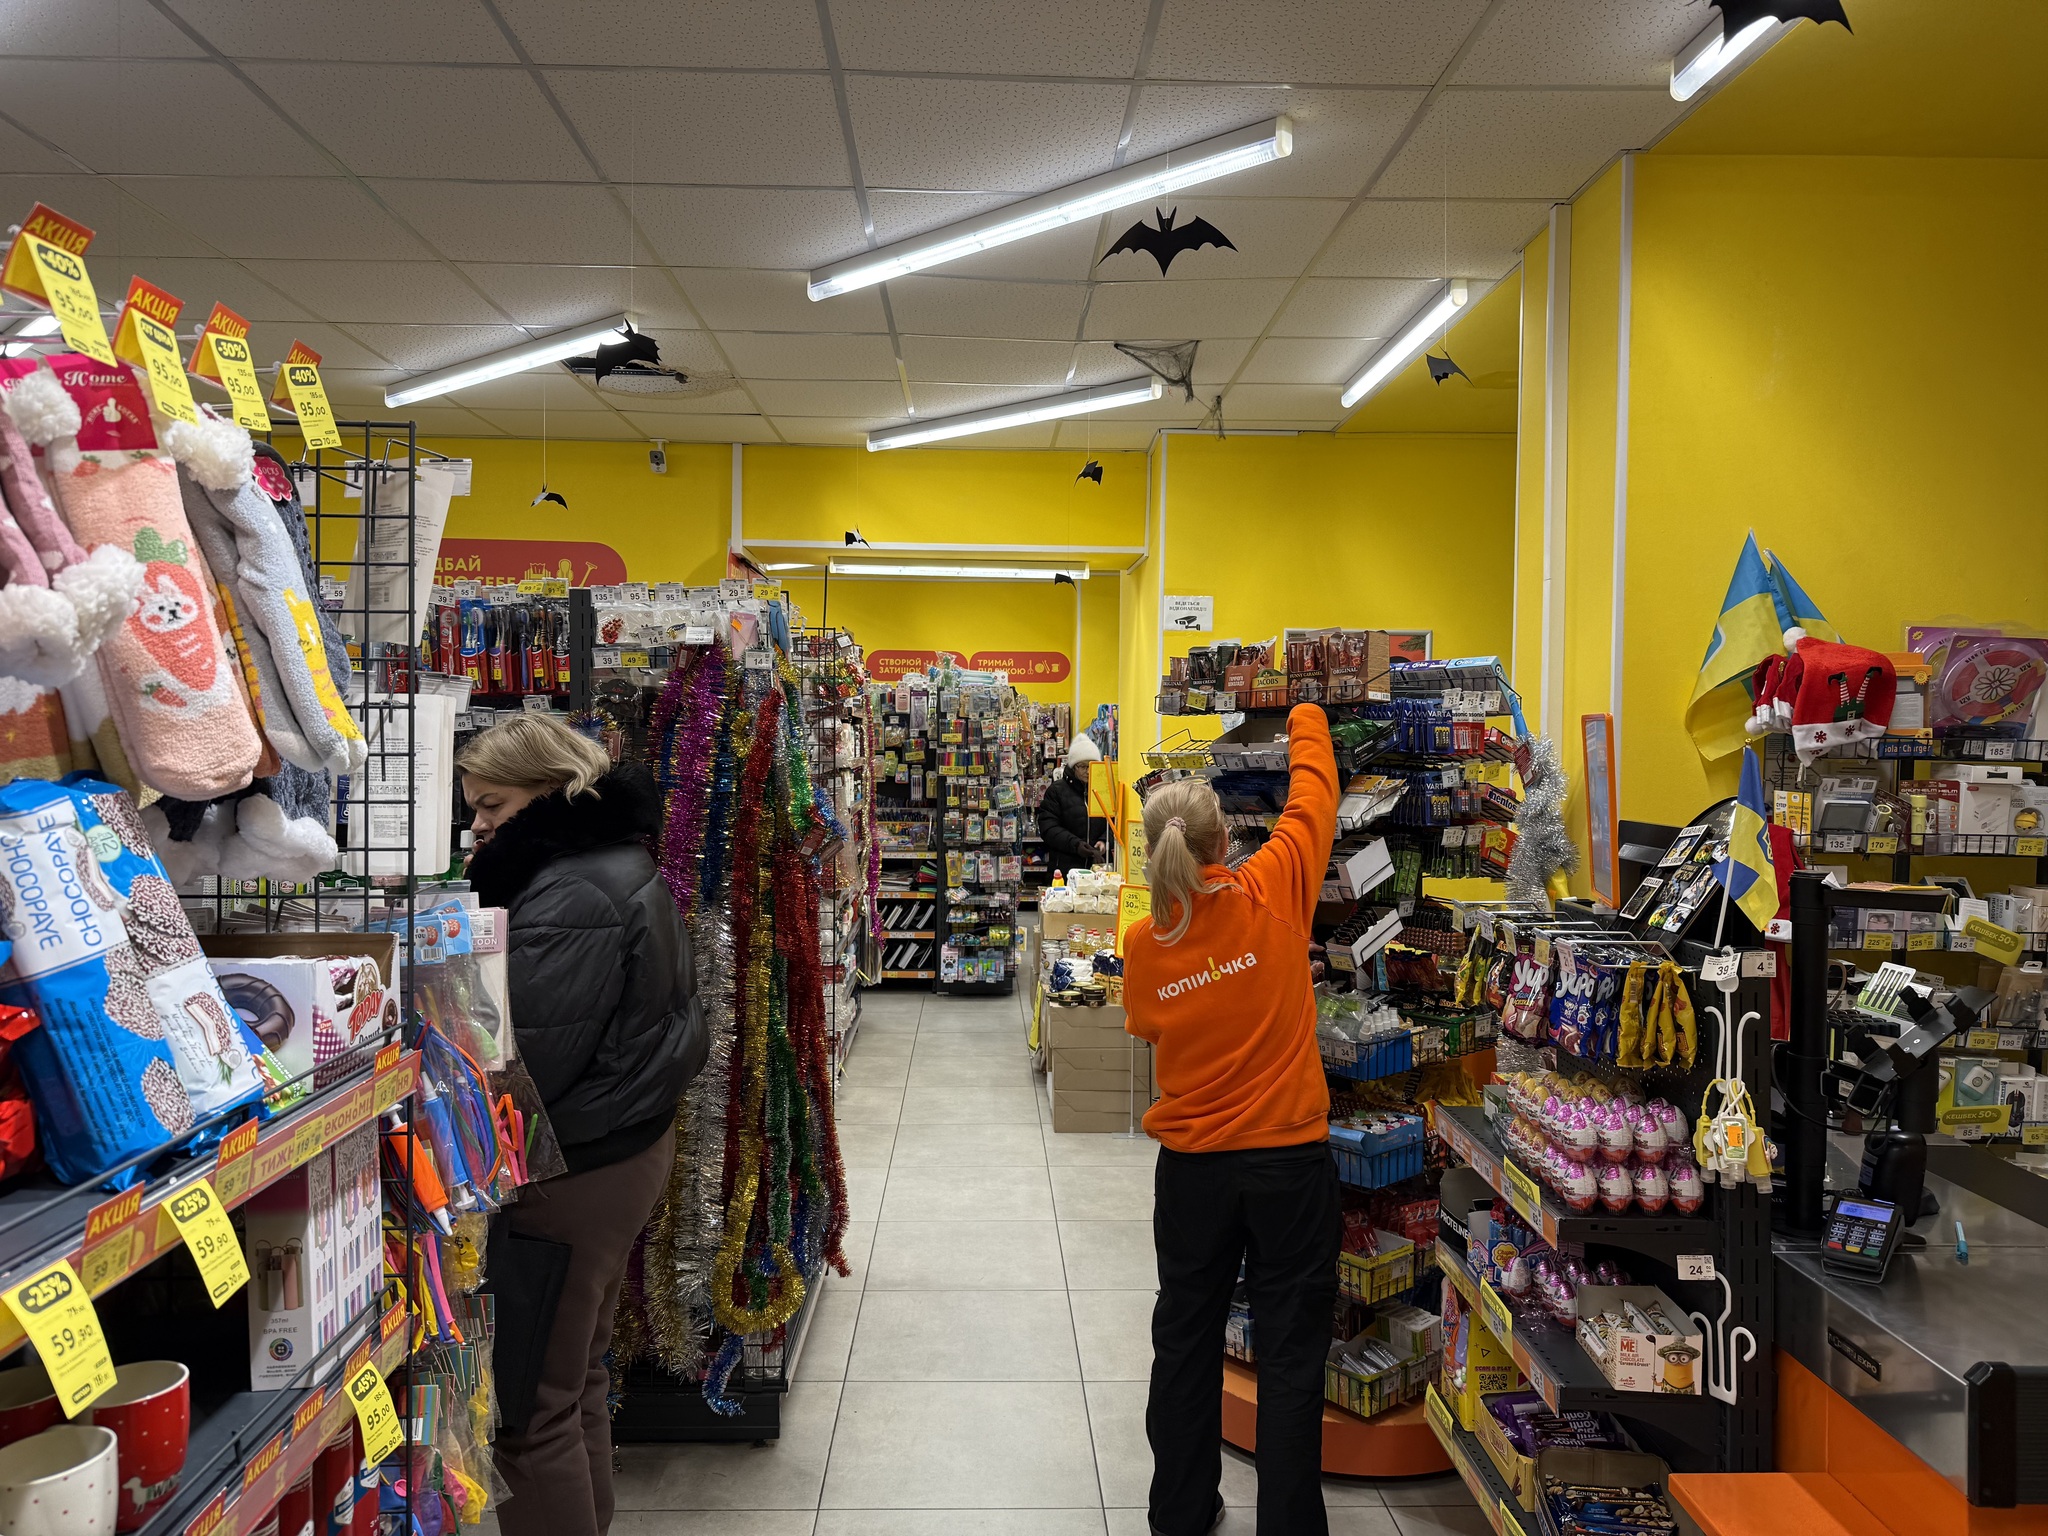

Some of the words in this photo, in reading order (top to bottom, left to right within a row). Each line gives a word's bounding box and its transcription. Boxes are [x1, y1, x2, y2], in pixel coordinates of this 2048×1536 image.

[26, 215, 89, 254] АКЦІЯ
[130, 288, 178, 323] АКЦІЯ
[211, 312, 246, 339] АКЦІЯ
[218, 341, 246, 359] -30%
[64, 371, 127, 386] Home
[153, 359, 182, 387] 95,00
[291, 370, 316, 382] -40%
[228, 377, 255, 395] 95,00
[300, 402, 326, 417] 95,00
[258, 466, 279, 476] SOCKS
[729, 589, 738, 597] 29
[879, 658, 922, 666] СТВОРЮЙ
[879, 666, 921, 674] ЗАТИШОК
[977, 658, 1014, 667] ТРИМАЙ
[1333, 667, 1357, 675] ORIGINAL
[2020, 662, 2031, 671] 12V
[1257, 678, 1278, 686] JACOBS
[1428, 710, 1451, 718] VARTA
[1990, 748, 2003, 756] 185
[1488, 790, 1518, 812] mentos
[1132, 829, 1142, 837] -20
[38, 814, 102, 947] CHOCOPAYE
[1970, 924, 1998, 940] КЕШБЕК
[1998, 934, 2016, 947] 50%
[1717, 966, 1729, 976] 39
[1757, 962, 1764, 971] 4
[349, 990, 384, 1044] TODAY
[376, 1046, 400, 1072] АКЦІЯ
[220, 1126, 257, 1163] АКЦІЯ
[88, 1188, 141, 1239] АКЦІЯ
[176, 1191, 207, 1217] -25%
[196, 1233, 228, 1259] 59,90
[1689, 1265, 1703, 1275] 24
[26, 1274, 70, 1307] -25%
[383, 1304, 405, 1338] АКЦІЯ
[1621, 1341, 1635, 1352] ME
[1858, 1354, 1878, 1375] EXPO
[356, 1371, 375, 1396] -45%
[294, 1395, 322, 1435] АКЦІЯ
[367, 1404, 389, 1430] 95,00
[246, 1437, 281, 1487] АКЦІЯ
